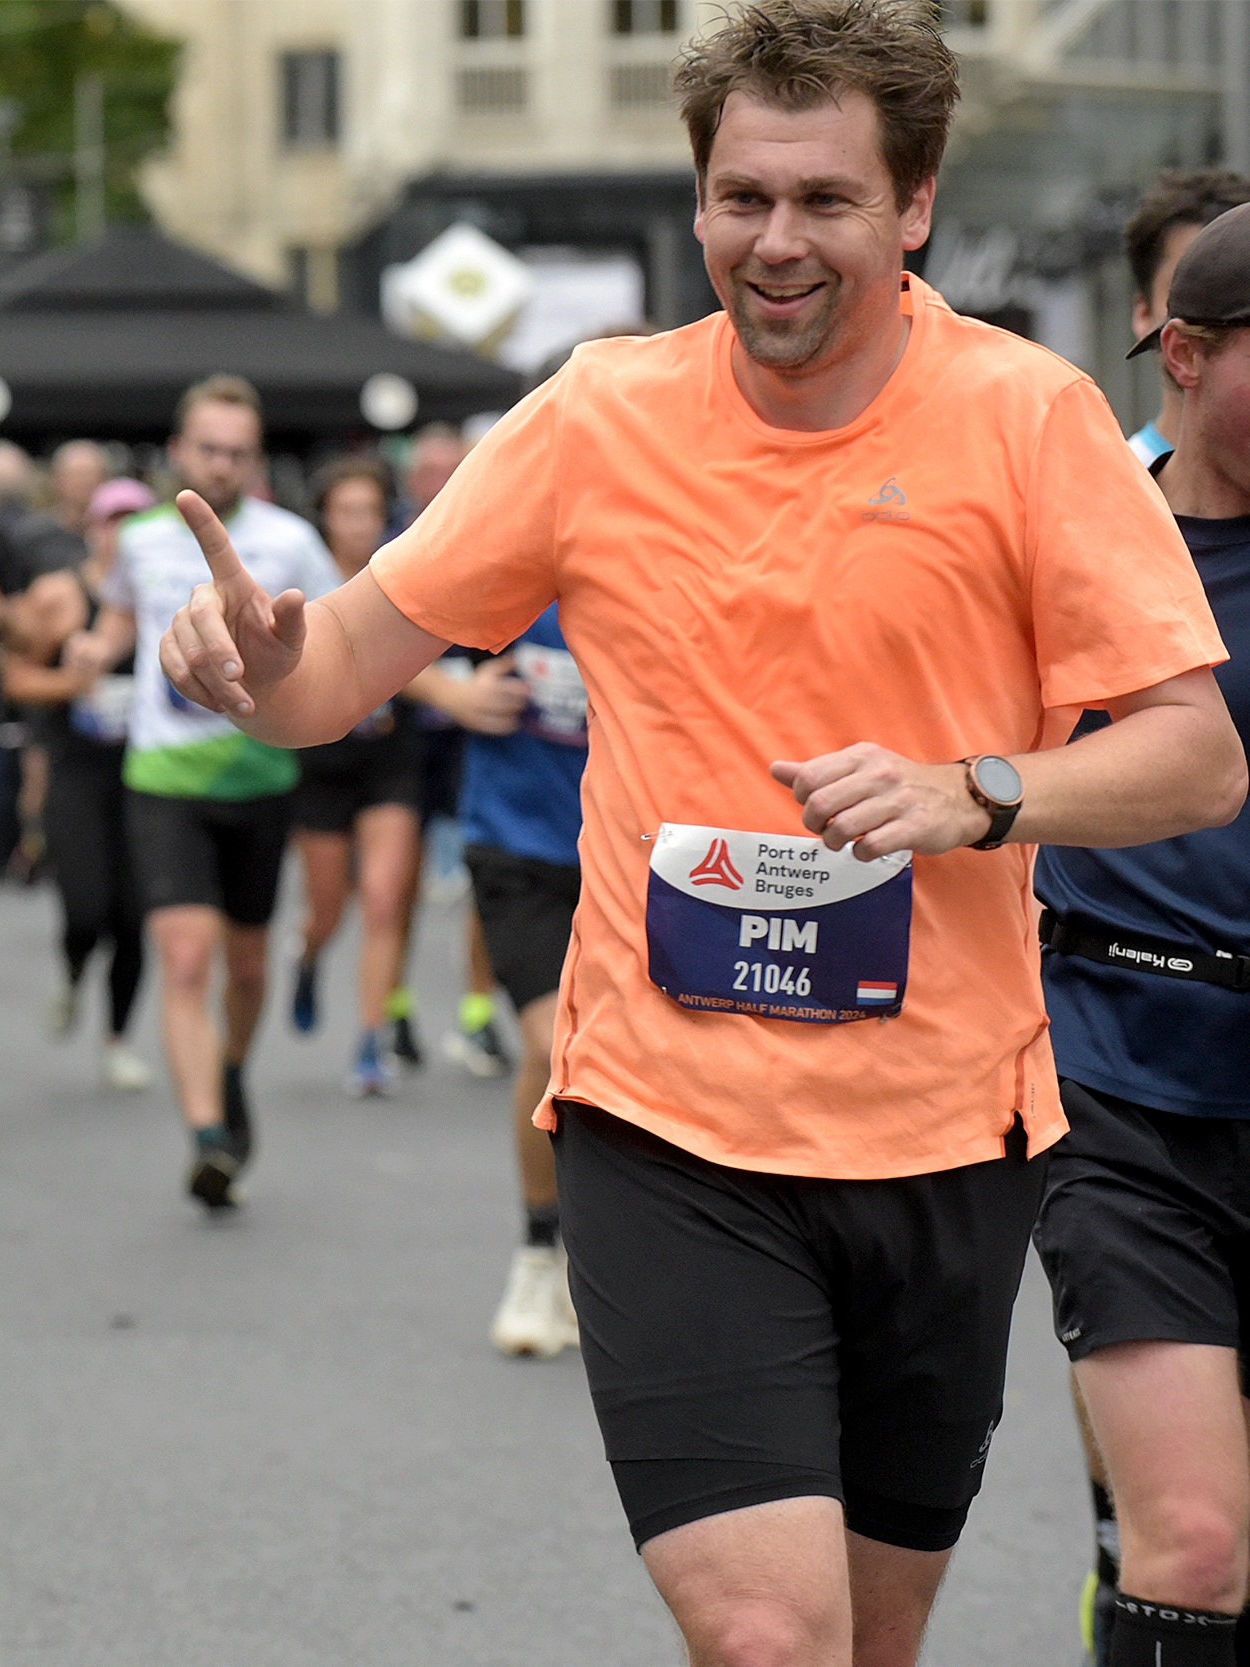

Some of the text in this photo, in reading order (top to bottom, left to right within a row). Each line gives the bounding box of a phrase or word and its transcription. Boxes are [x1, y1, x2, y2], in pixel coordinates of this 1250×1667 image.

[757, 843, 819, 862] Port of
[755, 861, 831, 885] Antwerp
[755, 879, 815, 899] Bruges
[738, 913, 819, 954] PIM
[1108, 942, 1166, 968] Kalenji
[732, 960, 812, 997] 21046
[677, 993, 867, 1021] ANTWERP HALF MARATHON 2024
